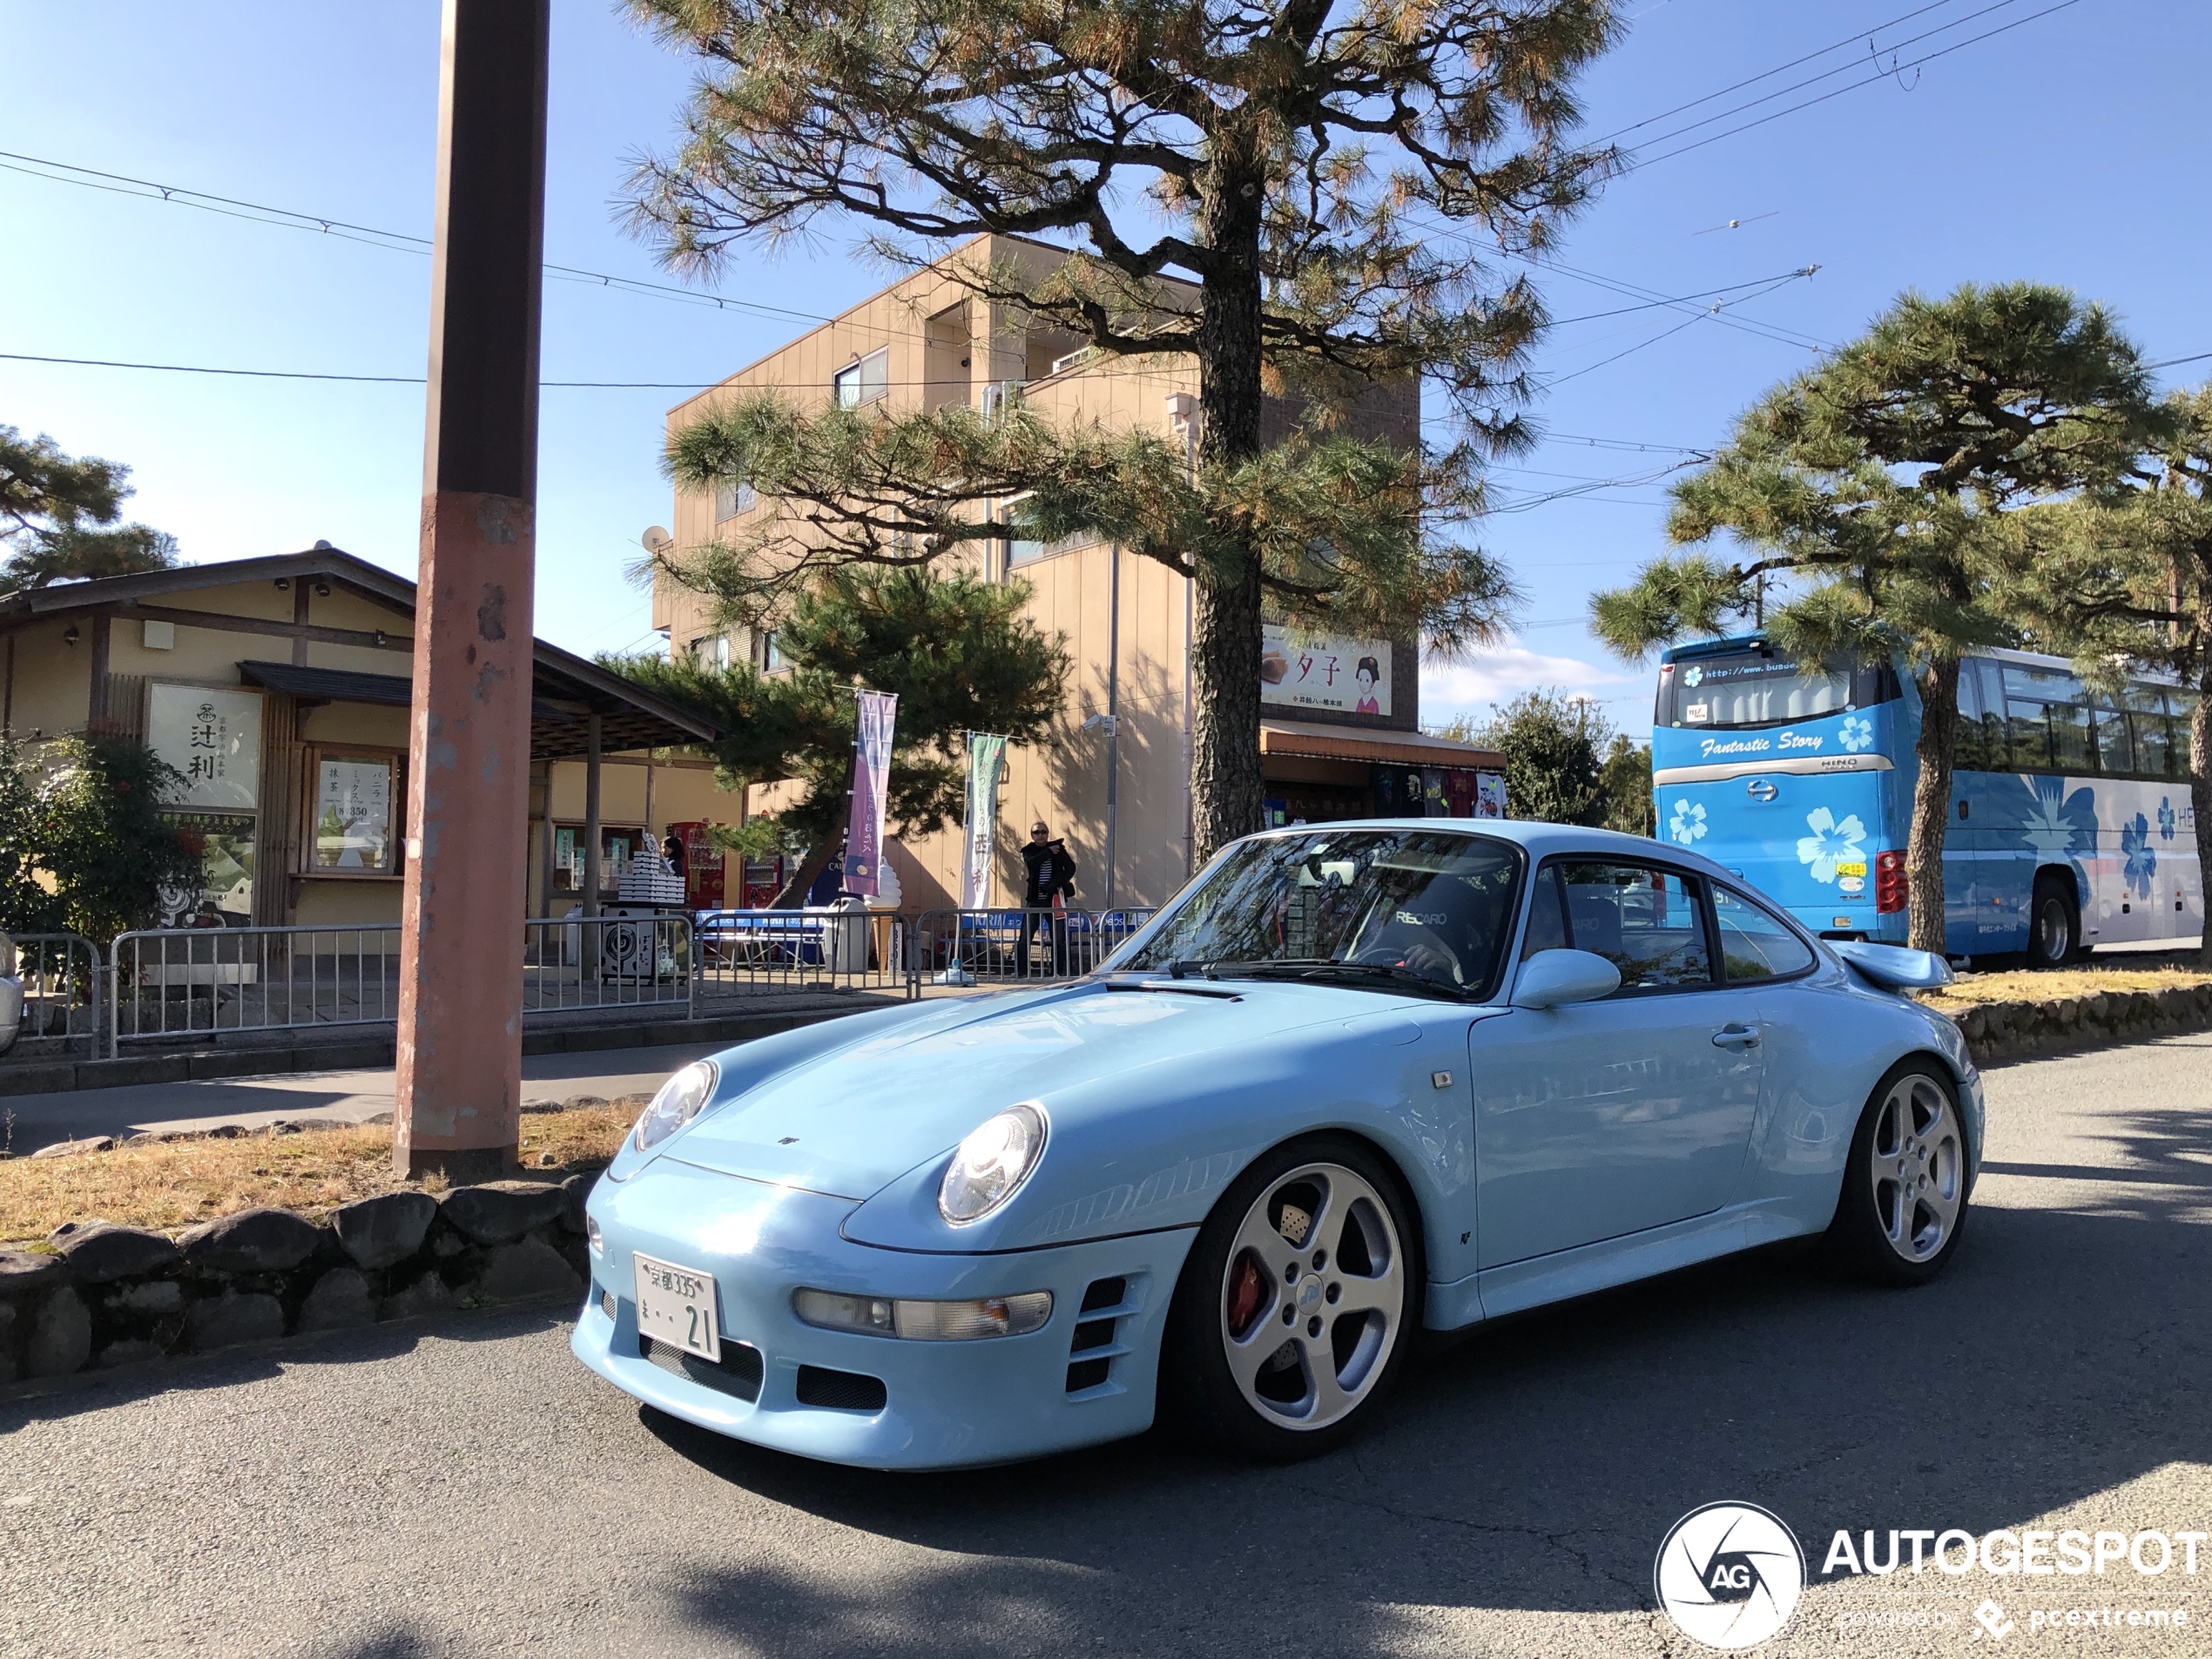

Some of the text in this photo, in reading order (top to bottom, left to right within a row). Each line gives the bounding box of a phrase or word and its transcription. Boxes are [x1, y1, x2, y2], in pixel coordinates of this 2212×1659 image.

[1296, 653, 1341, 686] 夕子
[187, 725, 216, 779] 辻利
[1701, 732, 1824, 759] Fantastic Story
[328, 768, 339, 792] 抹茶
[352, 770, 361, 799] ミックス
[372, 772, 382, 798] バニラ
[1395, 911, 1447, 925] RECARO
[685, 1305, 712, 1354] 21
